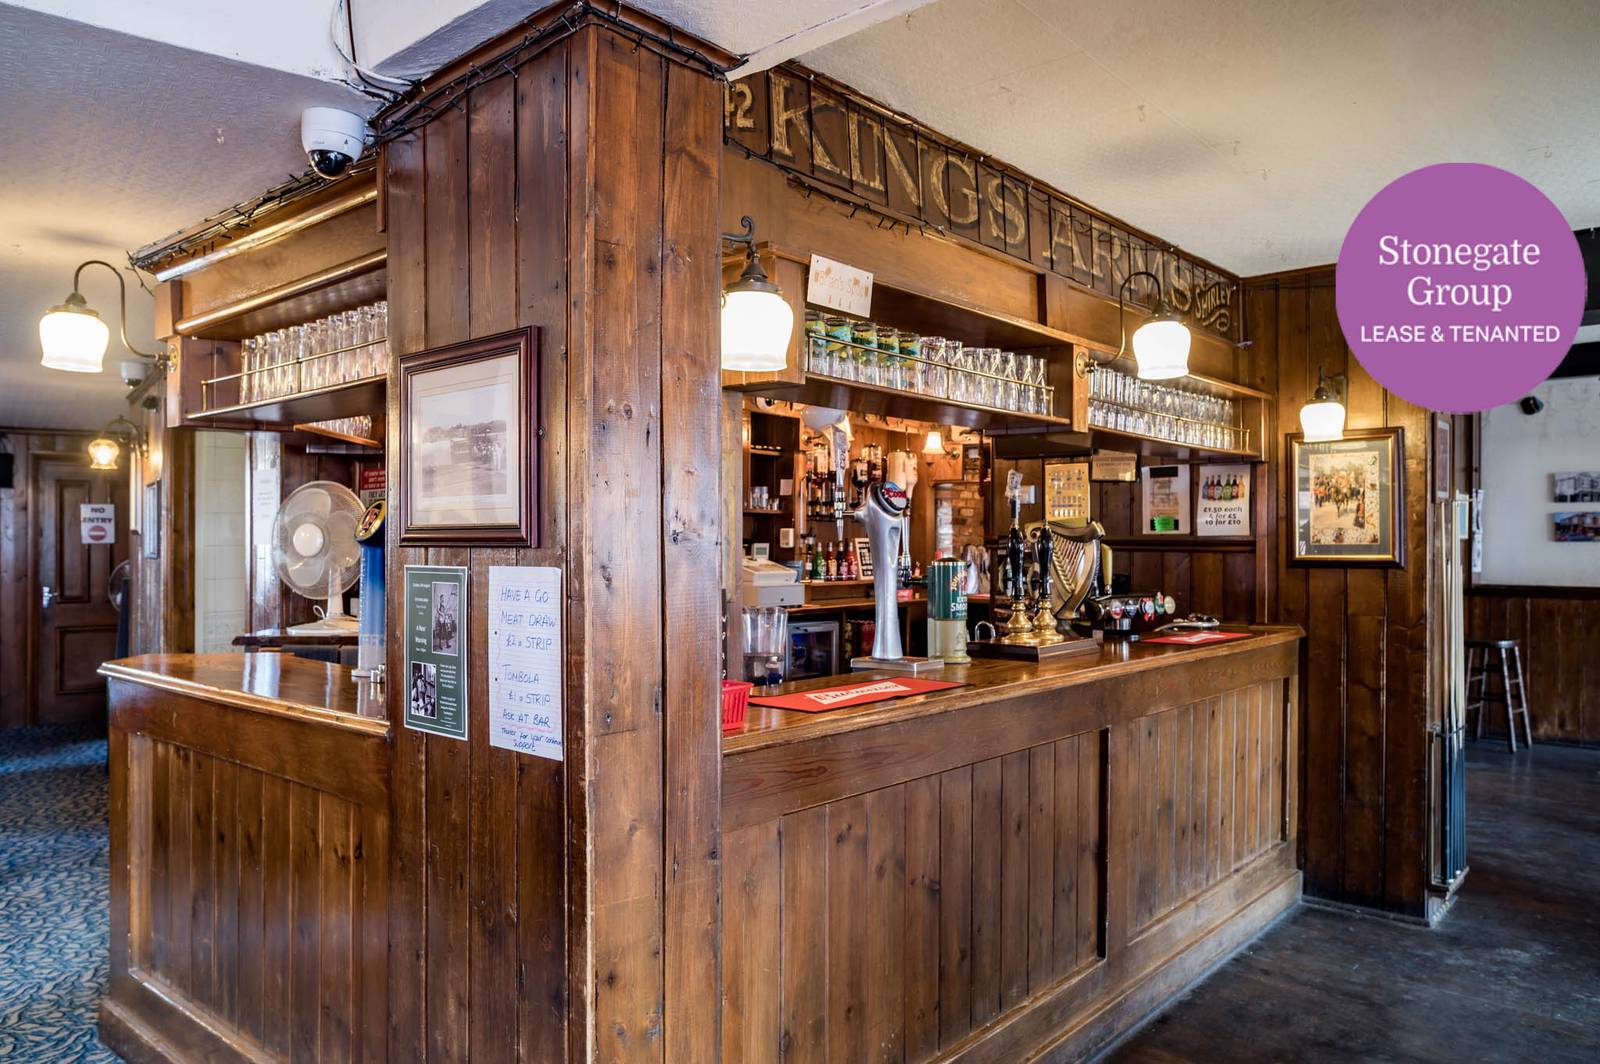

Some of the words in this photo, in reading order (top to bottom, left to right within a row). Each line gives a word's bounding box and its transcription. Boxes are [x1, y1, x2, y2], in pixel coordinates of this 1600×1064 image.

[769, 71, 1026, 245] KINGS
[1042, 206, 1192, 313] ARMS
[501, 586, 521, 601] HAVE
[524, 589, 530, 600] A
[535, 588, 549, 603] GO
[501, 610, 524, 625] MEAT
[529, 614, 555, 628] DRAW
[525, 636, 552, 651] STRIP
[501, 664, 540, 684] TOMBOLA
[526, 693, 551, 705] STRIP
[503, 709, 515, 721] ASK
[518, 713, 529, 723] AT
[533, 714, 551, 728] BAR
